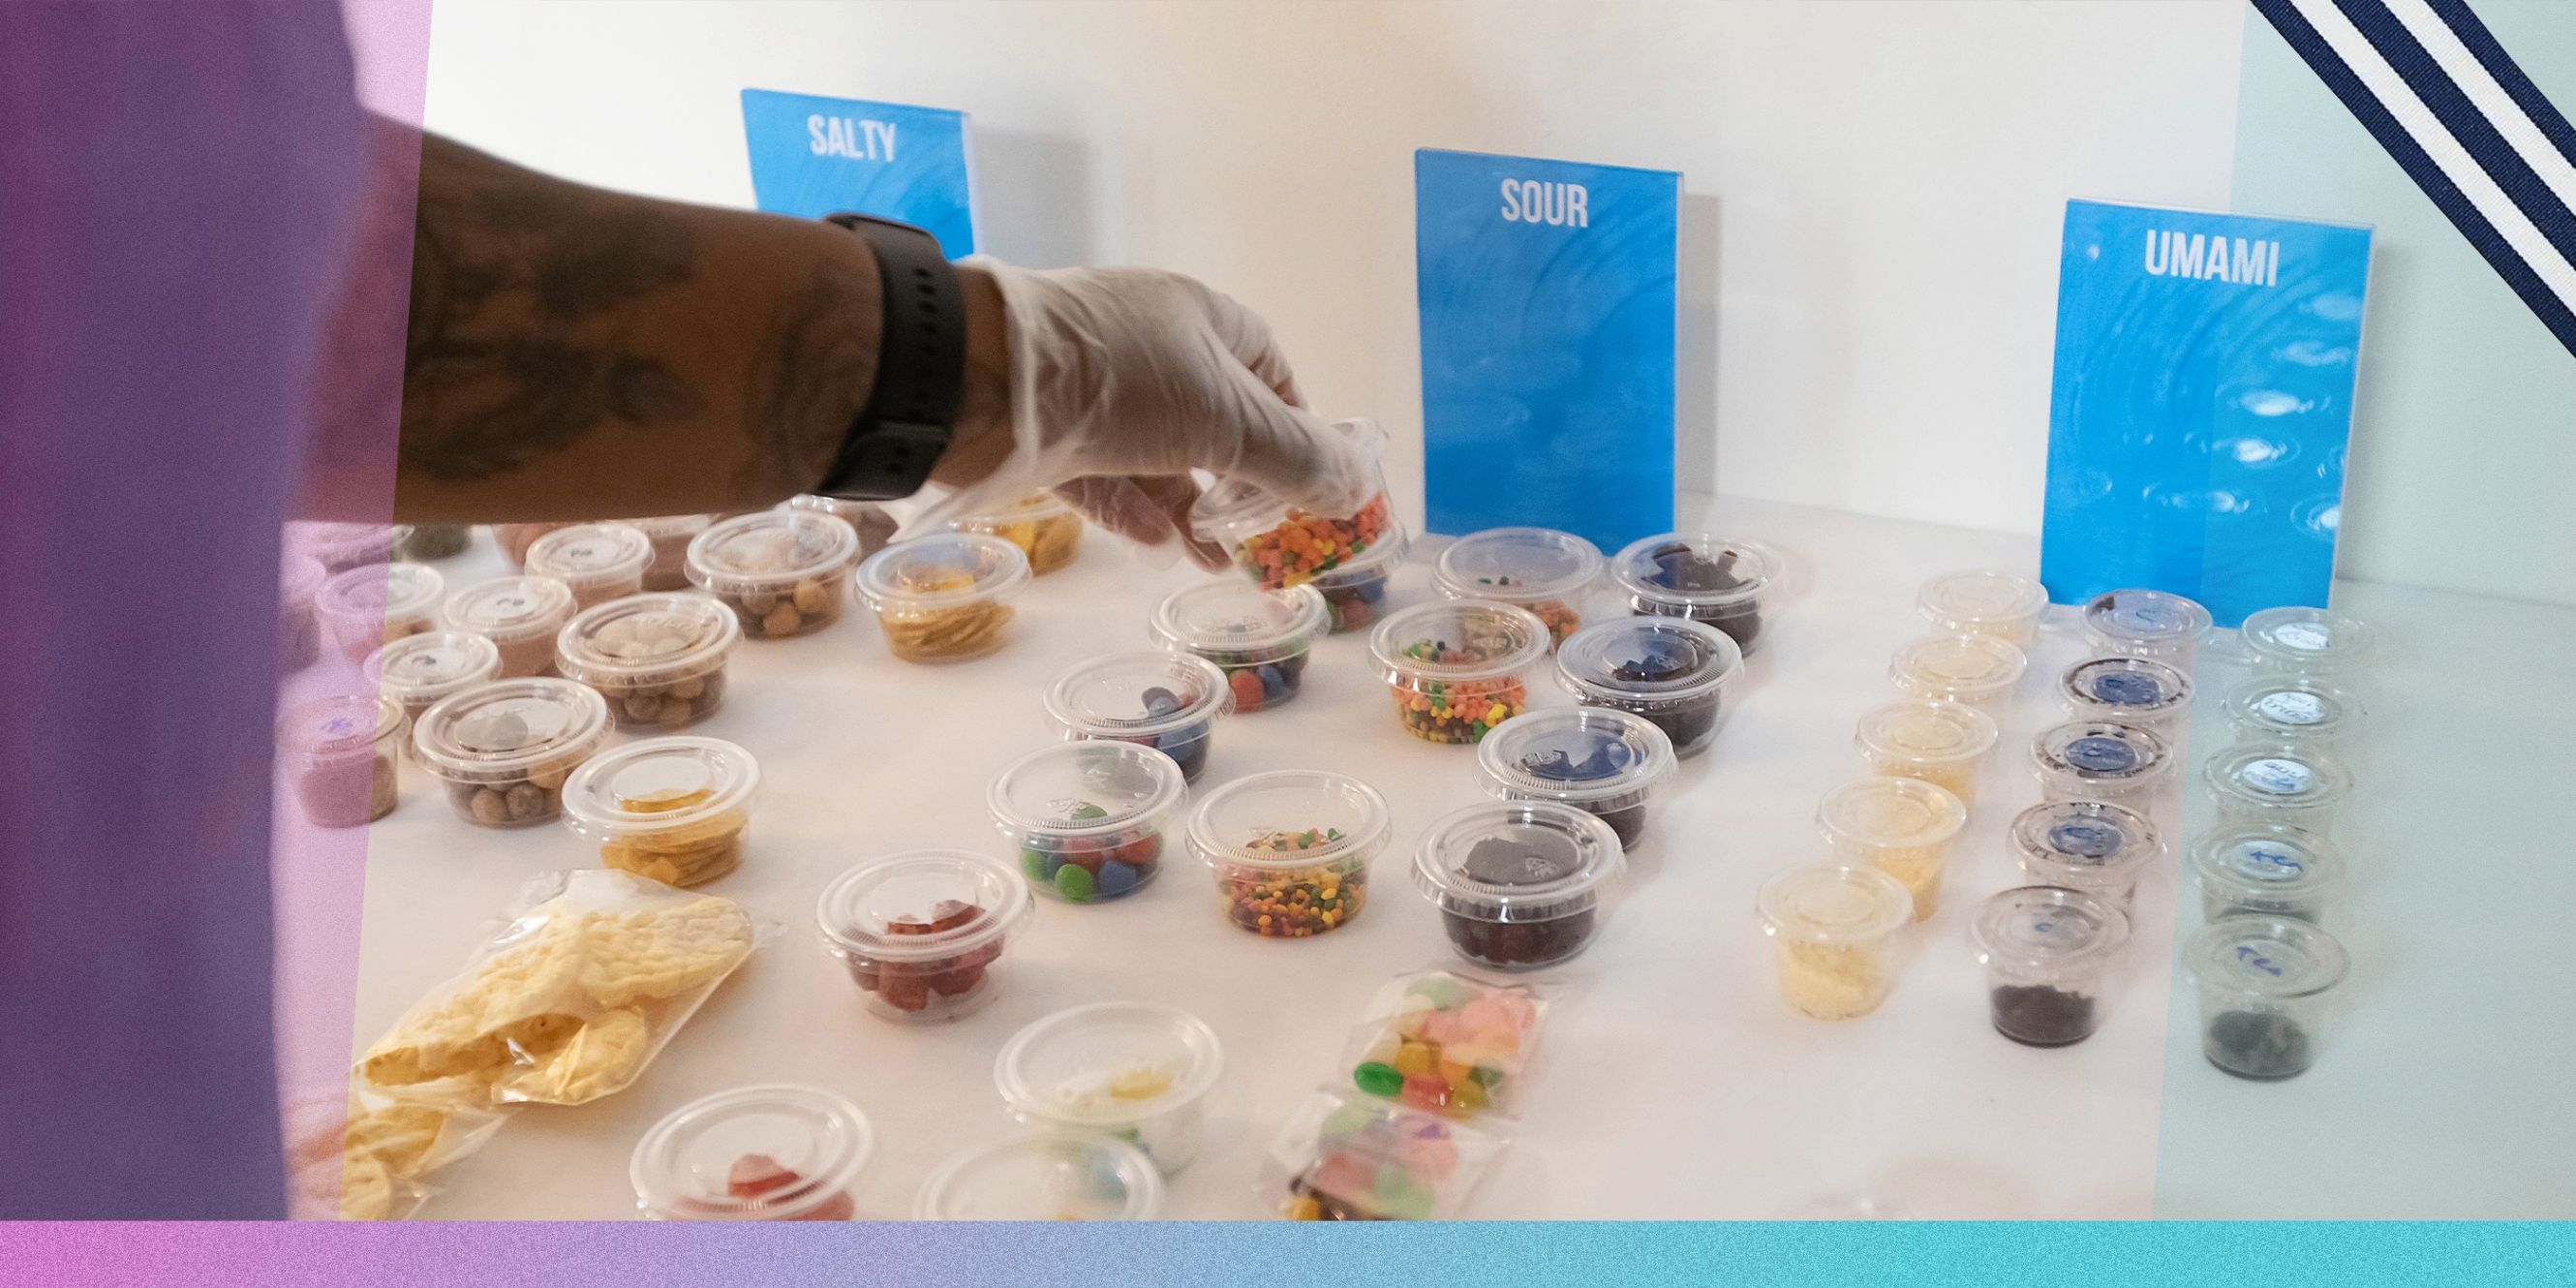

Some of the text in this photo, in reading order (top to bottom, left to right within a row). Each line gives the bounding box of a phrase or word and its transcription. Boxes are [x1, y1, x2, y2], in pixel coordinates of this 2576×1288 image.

[808, 113, 897, 162] SALTY
[1500, 177, 1589, 228] SOUR
[2144, 229, 2281, 288] UMAMI
